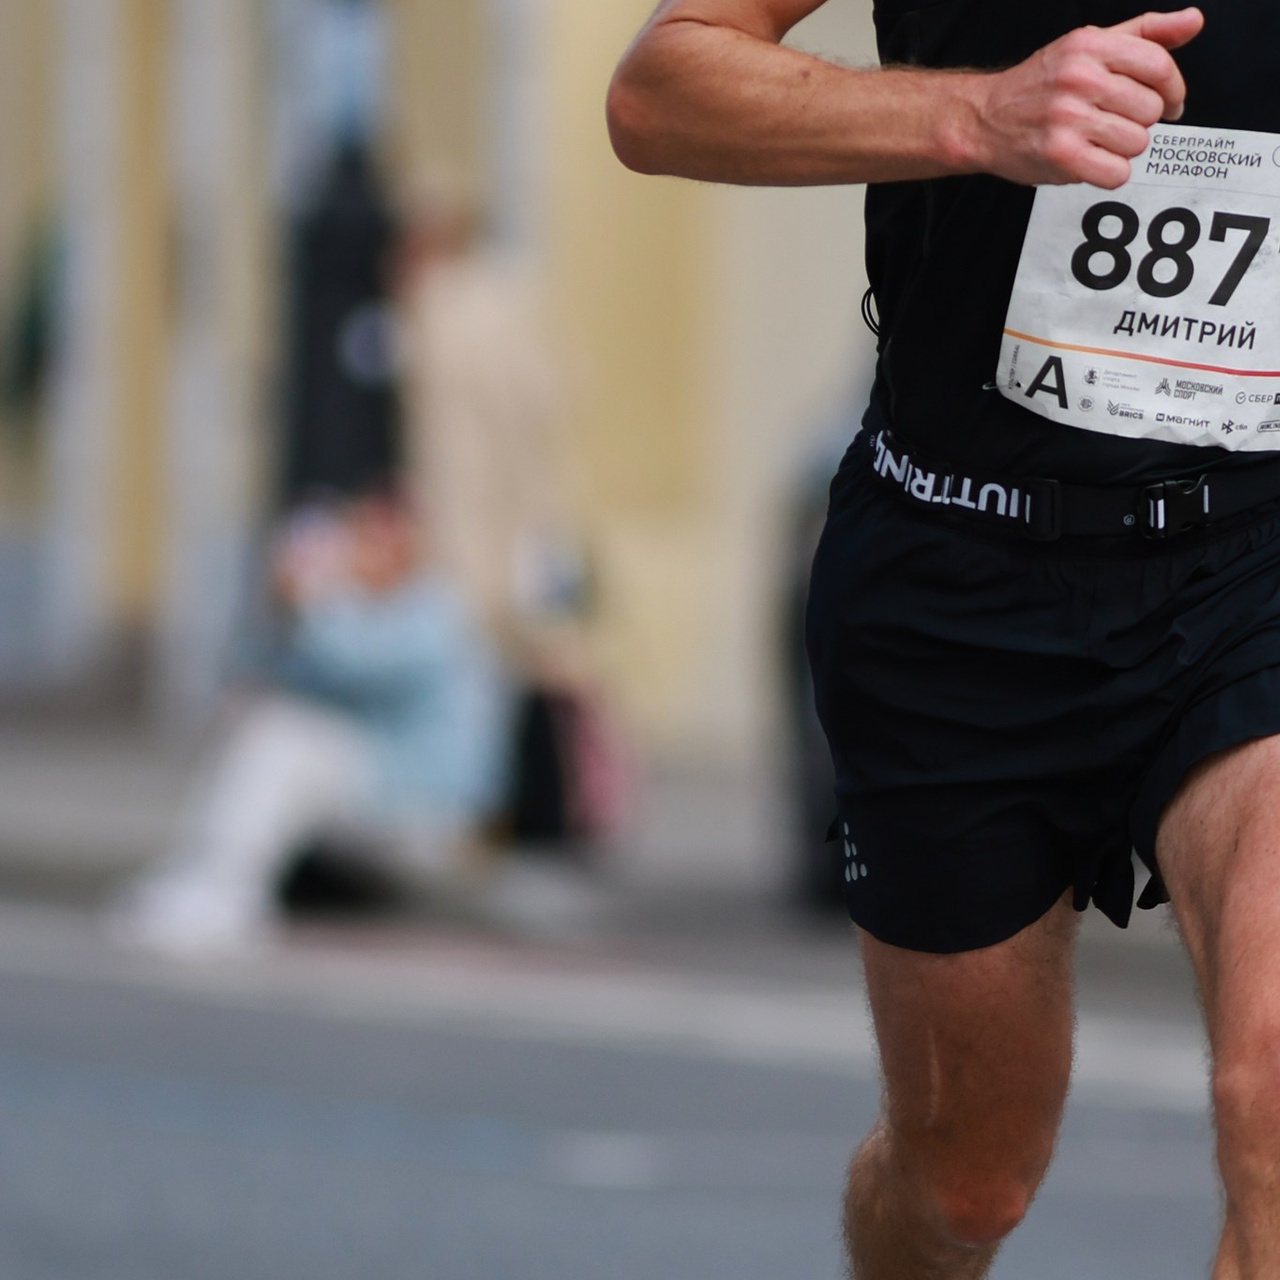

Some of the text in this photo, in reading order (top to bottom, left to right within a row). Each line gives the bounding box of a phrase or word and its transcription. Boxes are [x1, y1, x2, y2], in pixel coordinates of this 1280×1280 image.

[1153, 134, 1235, 150] СБЕРПРАЙМ
[1149, 147, 1262, 168] МОСКОВСКИЙ
[1146, 162, 1229, 179] МАРАФОН
[1113, 310, 1257, 350] ДМИТРИЙ
[1024, 355, 1069, 410] A
[1176, 380, 1223, 395] МОСКОВСКИЙ
[1174, 389, 1196, 400] СПОРТ
[1248, 394, 1273, 403] СБЕР
[1119, 410, 1143, 420] BRICS
